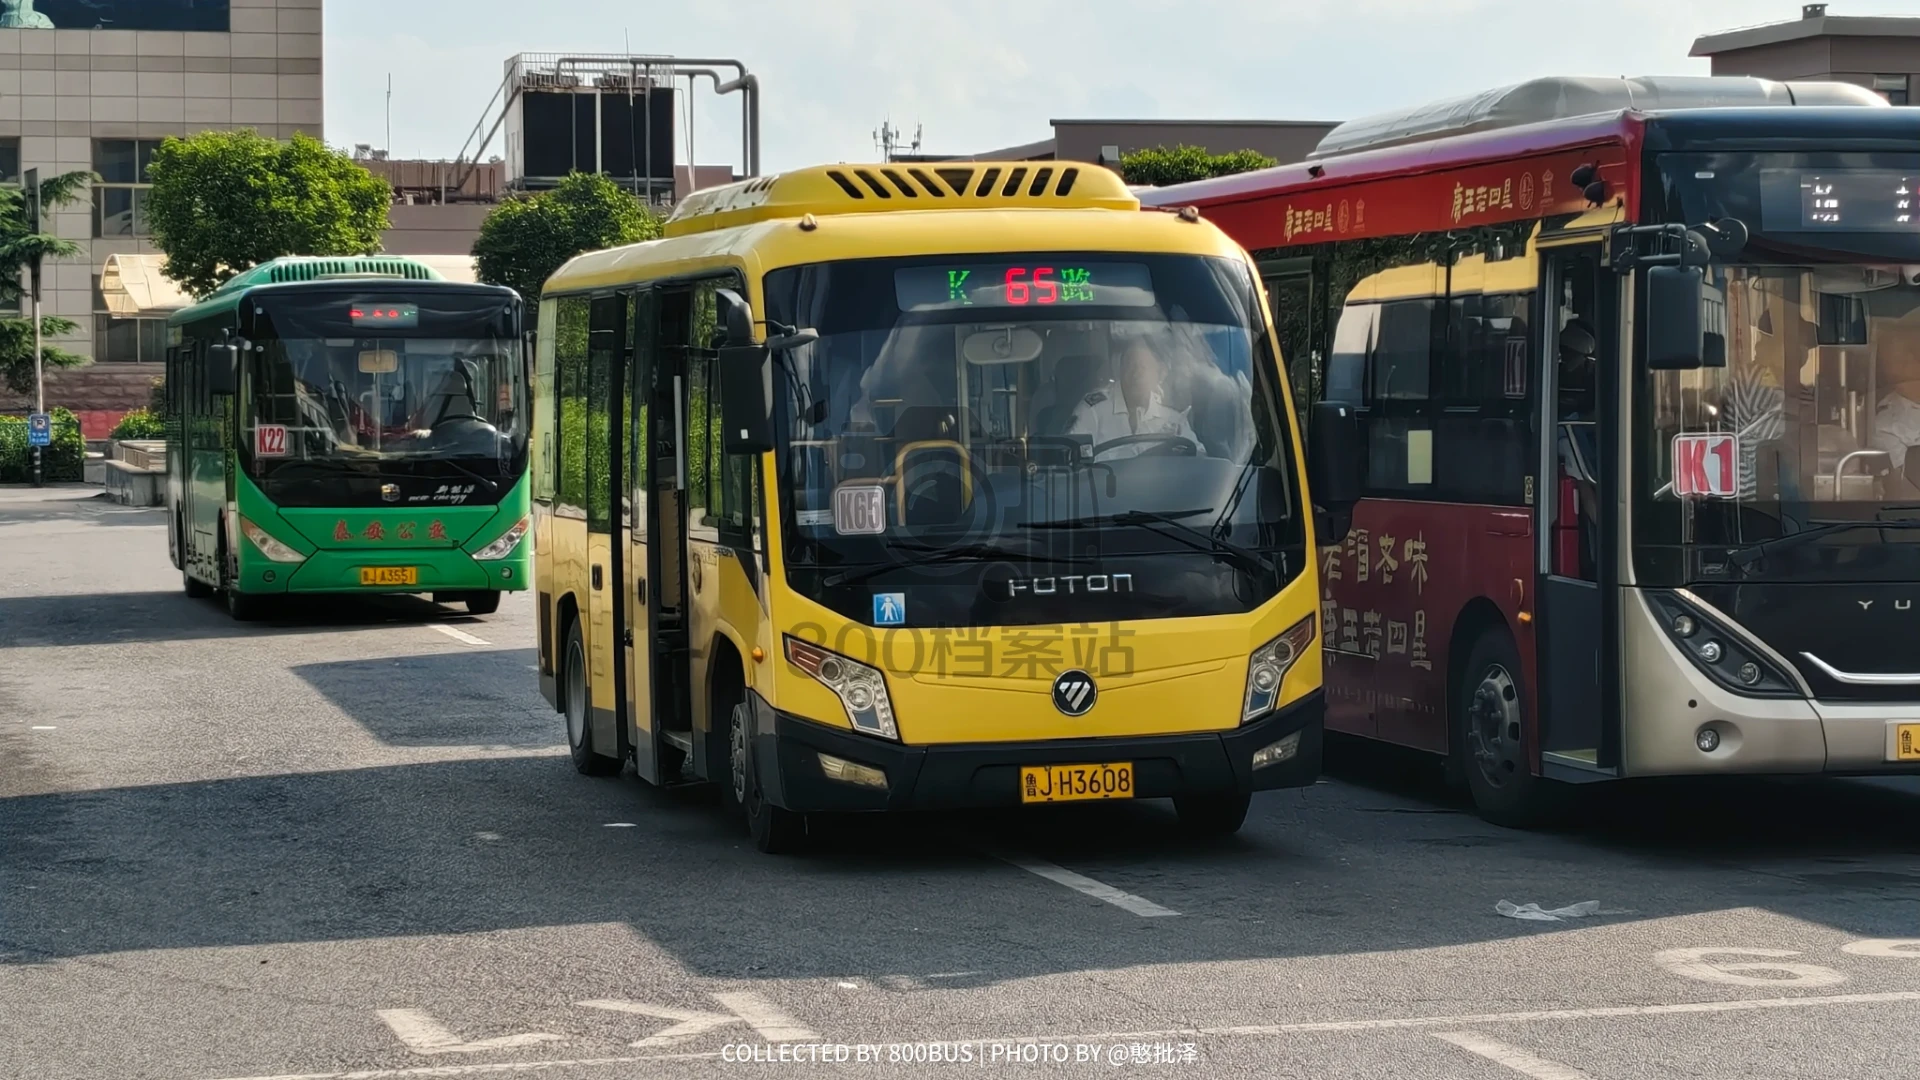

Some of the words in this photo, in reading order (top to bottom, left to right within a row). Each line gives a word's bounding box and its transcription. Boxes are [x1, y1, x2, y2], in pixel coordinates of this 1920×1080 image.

[948, 270, 972, 303] K
[258, 427, 285, 453] K22
[1679, 438, 1734, 493] K1
[839, 491, 881, 530] K65
[1008, 573, 1134, 597] FOTON
